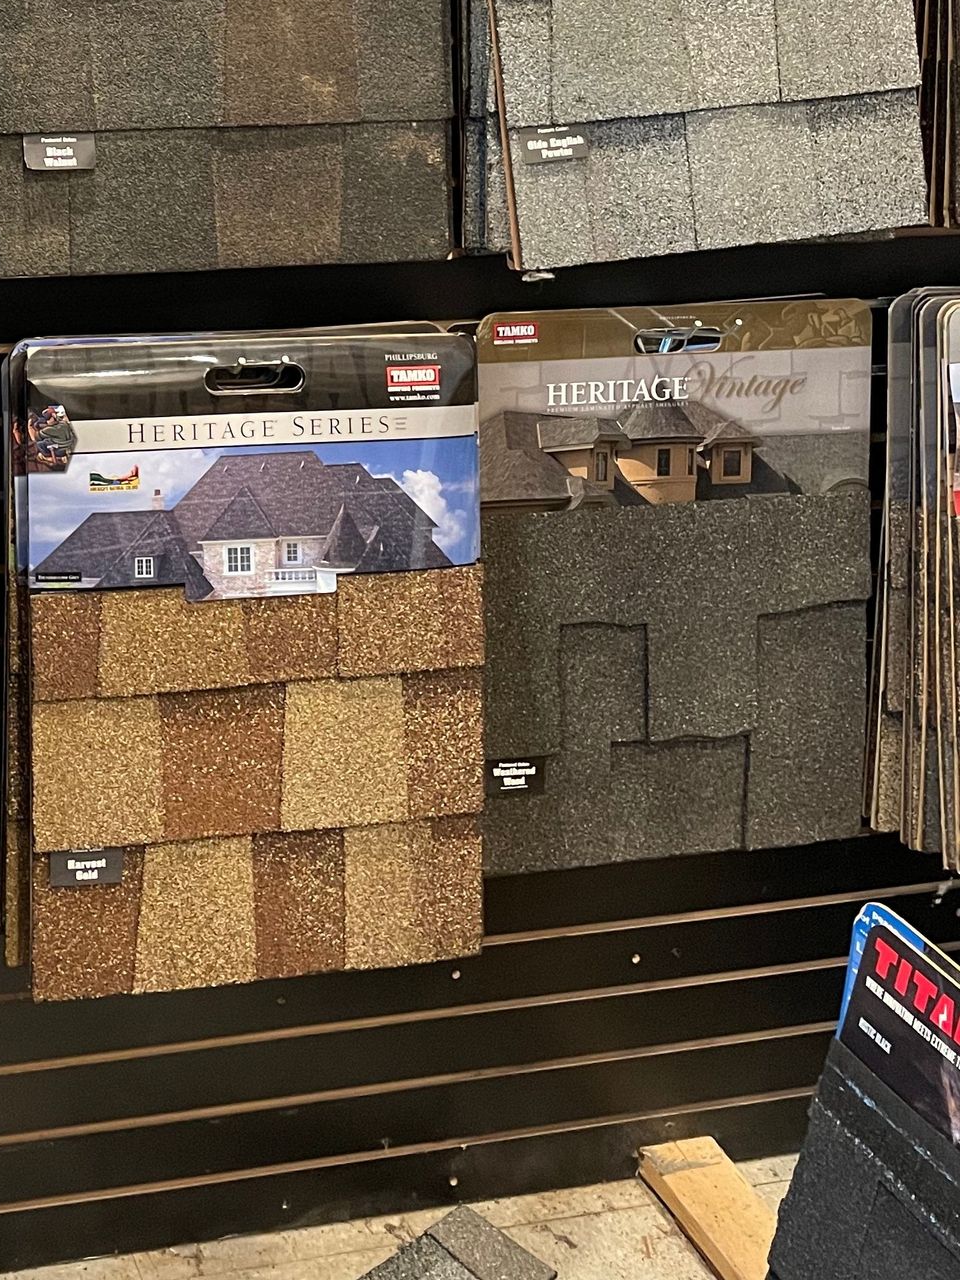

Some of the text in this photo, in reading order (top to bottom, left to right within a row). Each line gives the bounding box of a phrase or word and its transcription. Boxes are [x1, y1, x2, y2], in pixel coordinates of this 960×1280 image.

[496, 324, 535, 337] TAMKO
[384, 352, 438, 361] PHILLIPSBURG
[390, 368, 435, 383] TAMKO
[546, 355, 808, 414] HERITAGE Vintage
[127, 415, 390, 444] HERITAGE SERIES
[67, 858, 107, 870] Harvest
[75, 869, 99, 881] Gold
